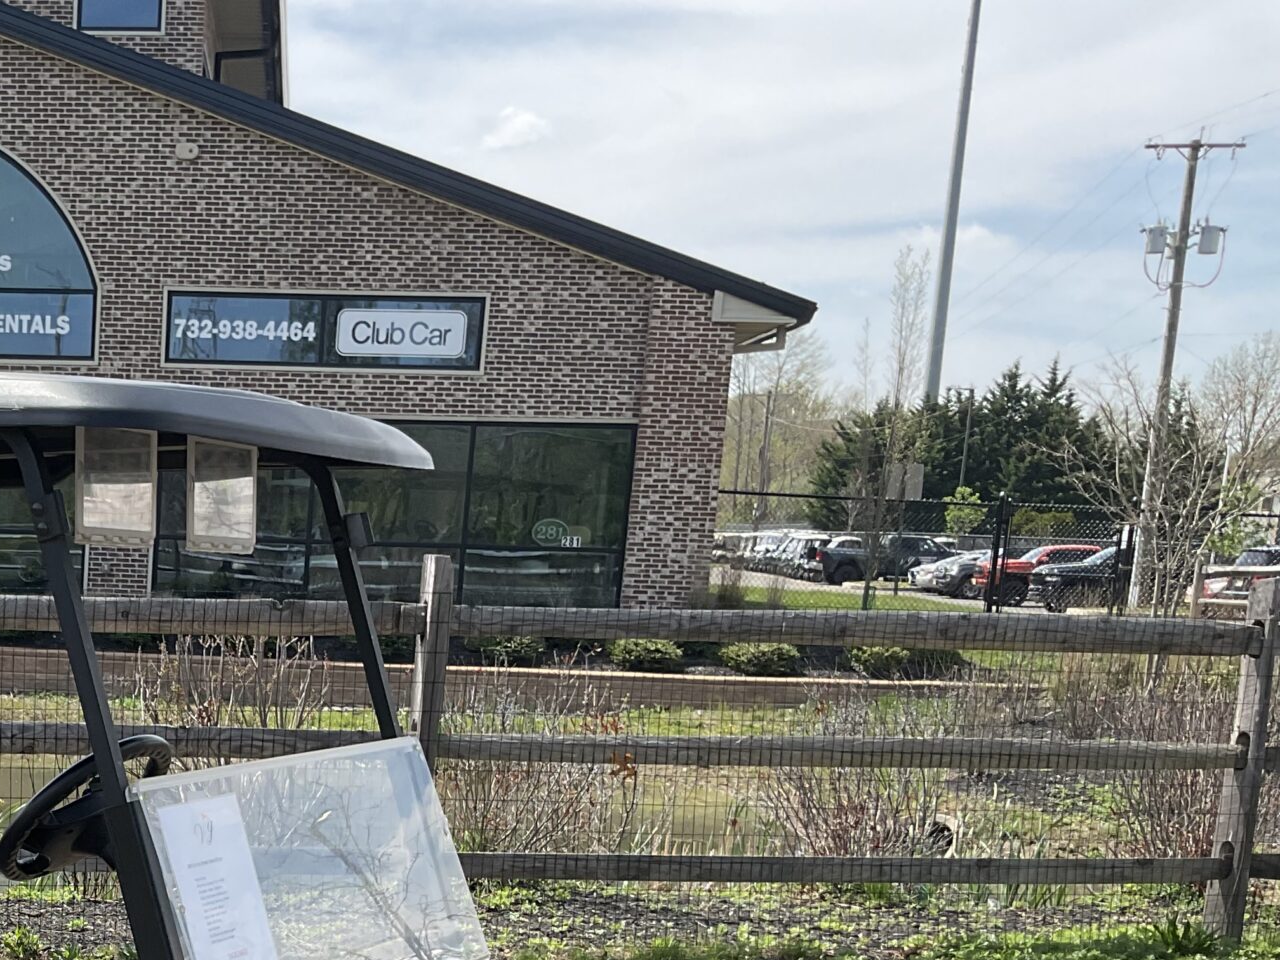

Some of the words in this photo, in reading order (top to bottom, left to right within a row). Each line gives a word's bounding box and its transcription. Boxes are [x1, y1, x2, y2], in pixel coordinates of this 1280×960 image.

[174, 318, 317, 342] 732-938-4464
[351, 320, 406, 345] Club
[409, 321, 452, 347] Car
[537, 525, 563, 540] 281
